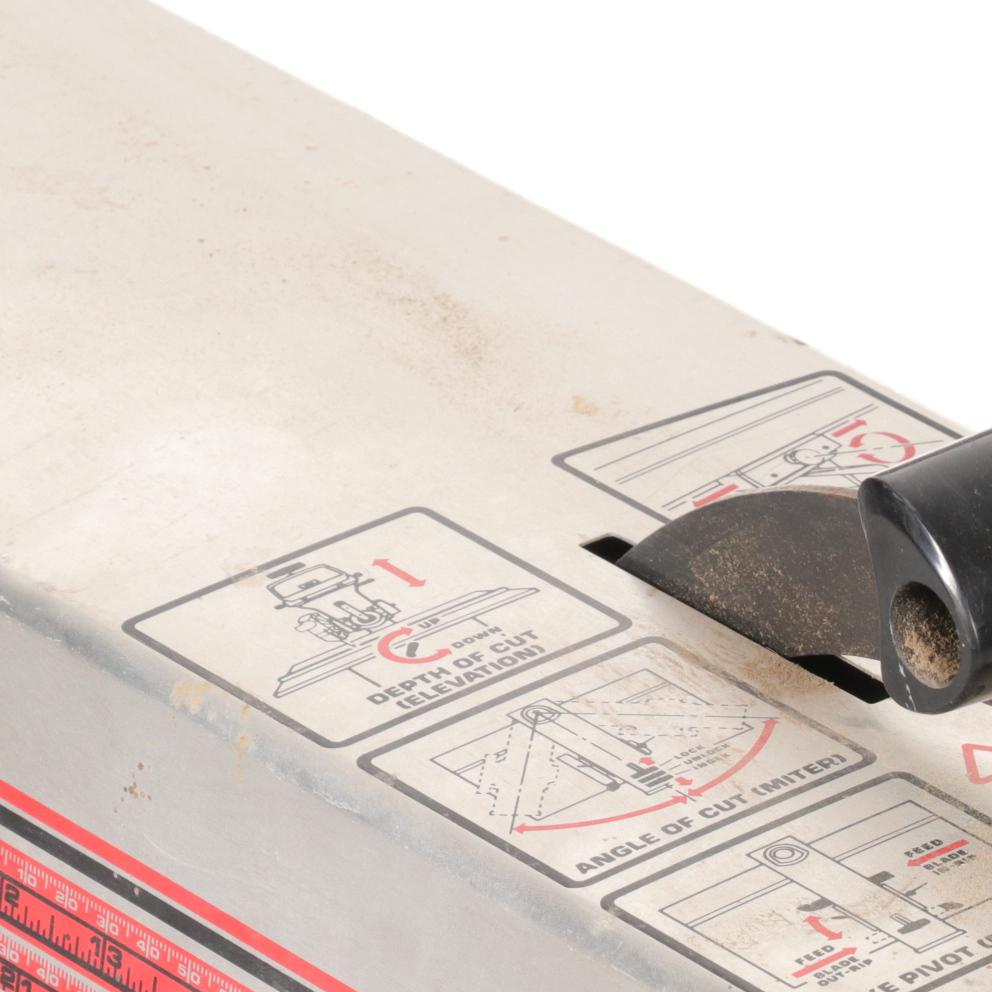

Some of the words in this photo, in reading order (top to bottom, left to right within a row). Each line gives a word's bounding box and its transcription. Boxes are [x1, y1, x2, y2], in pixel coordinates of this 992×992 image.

[418, 617, 440, 629] UP
[366, 666, 451, 705] DEPTH
[453, 652, 484, 670] OF
[489, 630, 539, 653] CUT
[396, 645, 546, 709] (ELEVATION)
[674, 744, 706, 759] LOCK
[575, 832, 661, 874] ANGLE
[661, 817, 695, 836] OF
[698, 794, 748, 819] CUT
[751, 753, 848, 796] (MITER)
[4, 883, 20, 907] 2
[90, 936, 122, 969] 13
[17, 868, 38, 888] 10
[55, 890, 78, 911] 20
[97, 914, 119, 936] 30
[136, 939, 160, 960] 40
[177, 963, 201, 986] 50
[0, 945, 19, 963] 30
[37, 968, 59, 987] 40
[794, 944, 836, 966] FEED
[813, 956, 859, 980] BLADE
[817, 958, 873, 987] OUT-RIP
[900, 945, 977, 984] PIVOT
